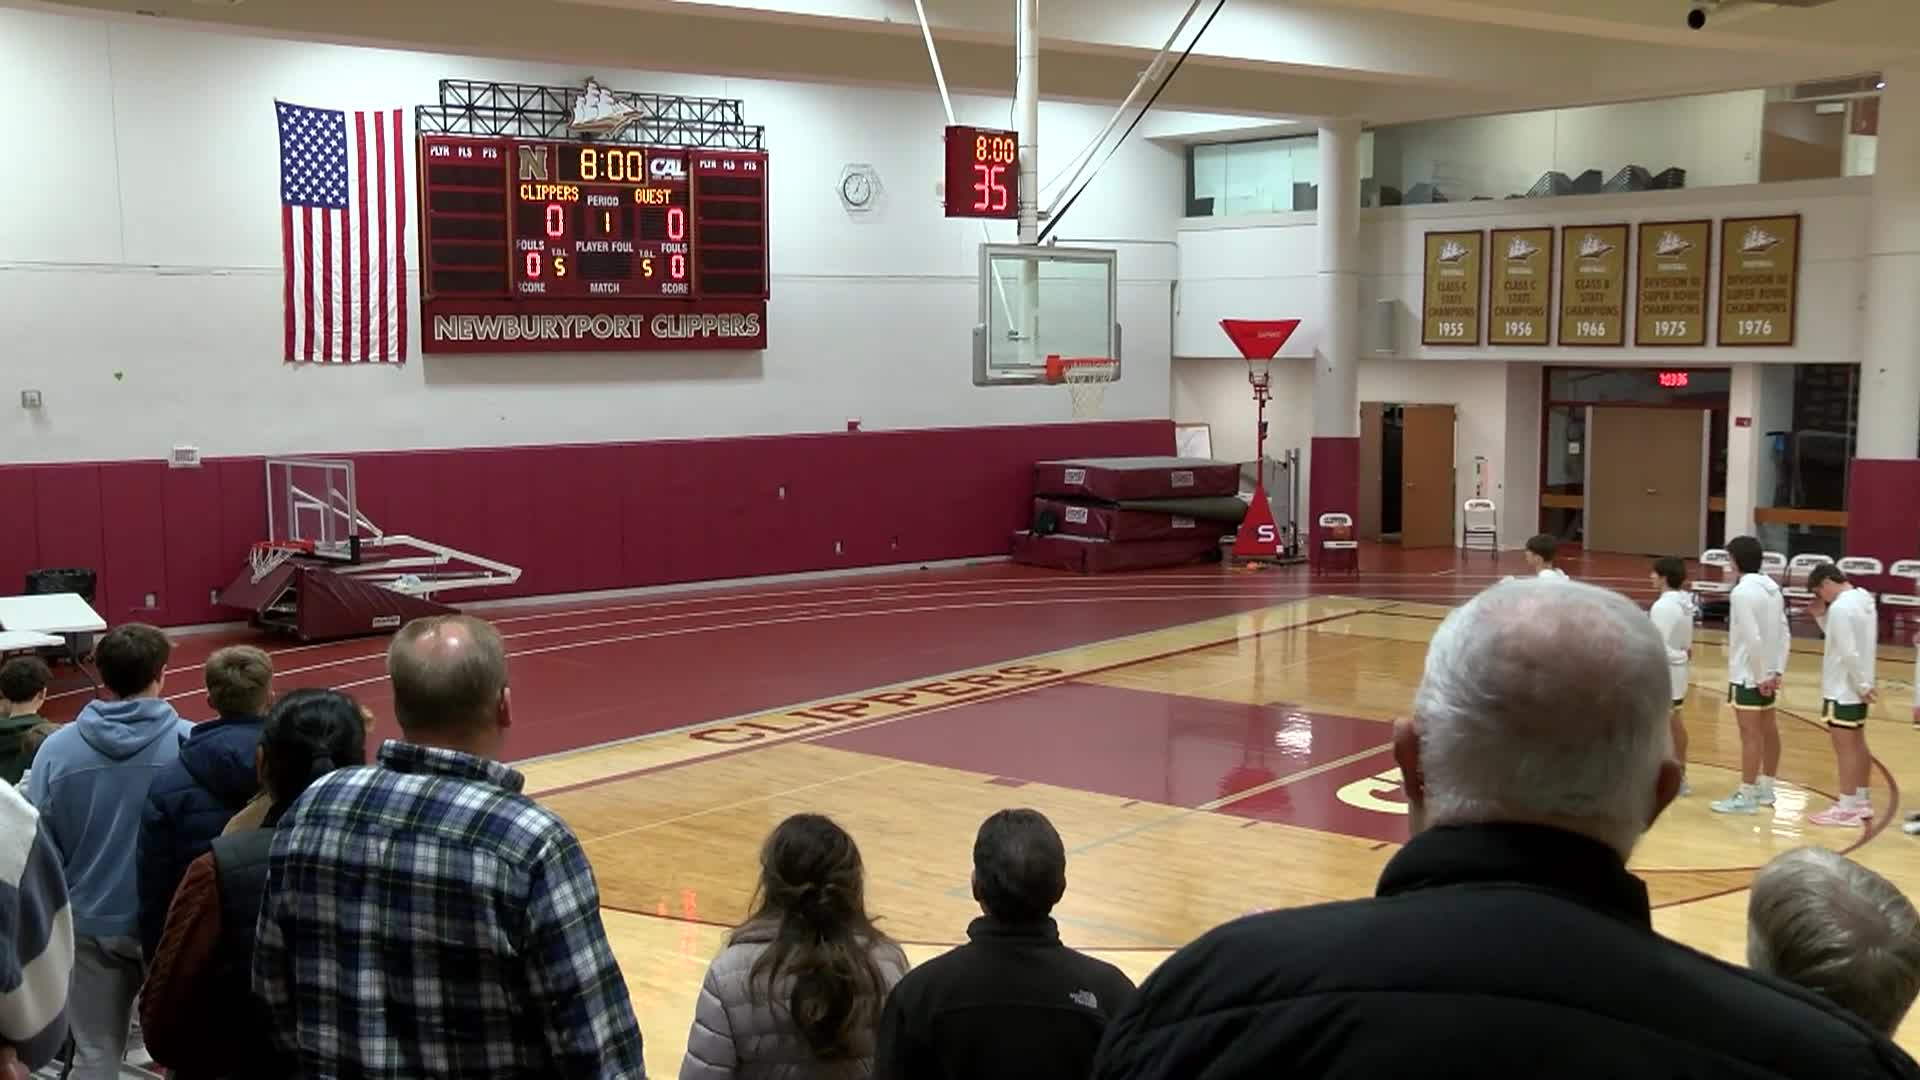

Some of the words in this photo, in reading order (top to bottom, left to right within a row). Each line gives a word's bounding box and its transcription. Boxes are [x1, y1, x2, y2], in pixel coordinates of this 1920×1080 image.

[482, 148, 497, 159] PTS
[976, 135, 1015, 164] 8:00
[519, 145, 548, 180] N
[580, 149, 643, 181] 8:00
[650, 158, 687, 176] CAL
[520, 184, 579, 201] CLIPPERS
[974, 164, 1007, 211] 35
[587, 195, 619, 206] PERIOD
[635, 189, 671, 204] GUEST
[546, 205, 563, 236] 0
[668, 208, 684, 239] 0
[516, 240, 544, 250] FOULS
[576, 241, 608, 252] PLAYER
[611, 242, 634, 252] FOUL
[661, 243, 688, 254] FOULS
[526, 252, 541, 277] 0
[671, 255, 684, 278] 0
[590, 283, 620, 293] MATCH
[662, 283, 688, 293] SCORE
[434, 314, 644, 340] NEWBURYPORT
[651, 313, 760, 338] CLIPPERS
[1438, 322, 1464, 337] 1955
[1505, 321, 1532, 337] 1956
[1576, 321, 1606, 337] 1966
[1655, 320, 1687, 336] 1975
[1738, 320, 1772, 336] 1976
[1258, 525, 1274, 542] S
[689, 665, 1063, 745] CLIPPERS
